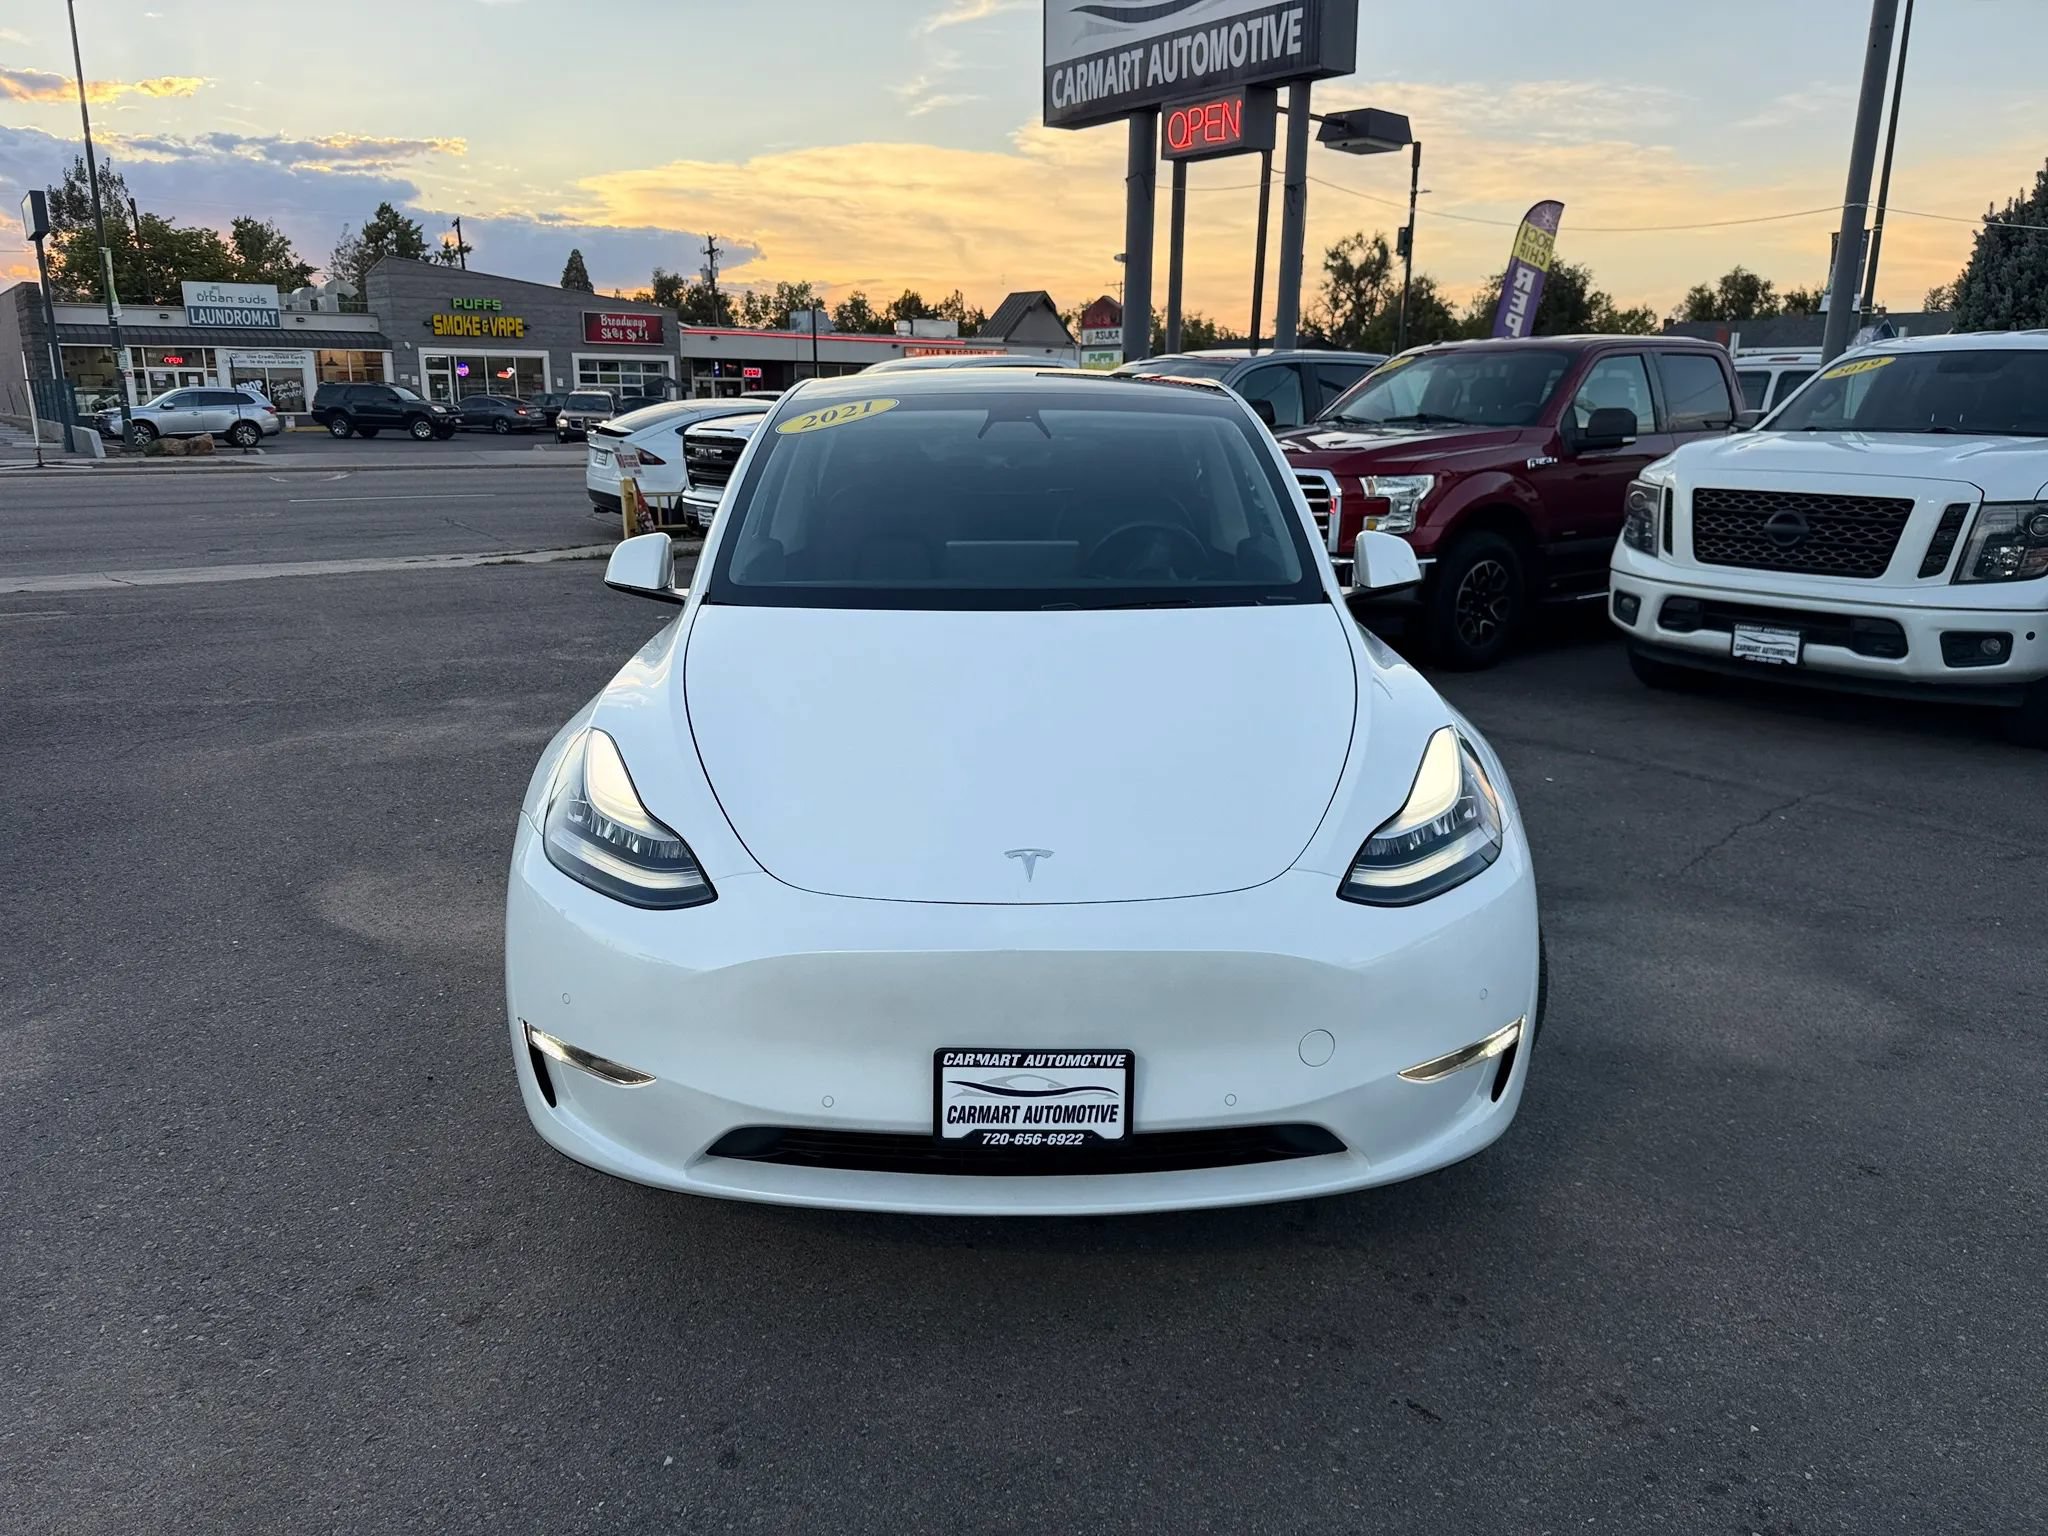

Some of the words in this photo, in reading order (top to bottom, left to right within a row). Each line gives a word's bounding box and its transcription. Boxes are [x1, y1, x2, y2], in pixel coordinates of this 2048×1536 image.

[1052, 48, 1143, 109] CARMART
[1147, 7, 1303, 88] AUTOMOTIVE
[1168, 99, 1242, 149] OPEN
[238, 295, 267, 305] suds
[452, 297, 503, 311] PUFFS
[190, 308, 277, 326] LAUNDROMAT
[600, 314, 647, 329] Broadways
[432, 314, 481, 336] SMOKE
[481, 319, 490, 333] &
[489, 316, 525, 338] VAPE
[163, 356, 183, 364] OPEN
[801, 401, 873, 429] 2021
[1735, 643, 1761, 653] CARMART
[943, 1053, 1021, 1067] CARMART
[1023, 1054, 1126, 1067] AUTOMOTIVE
[947, 1105, 1021, 1124] CARMART
[1022, 1104, 1119, 1124] AUTOMOTIVE
[981, 1132, 1085, 1146] 720-656-6922
